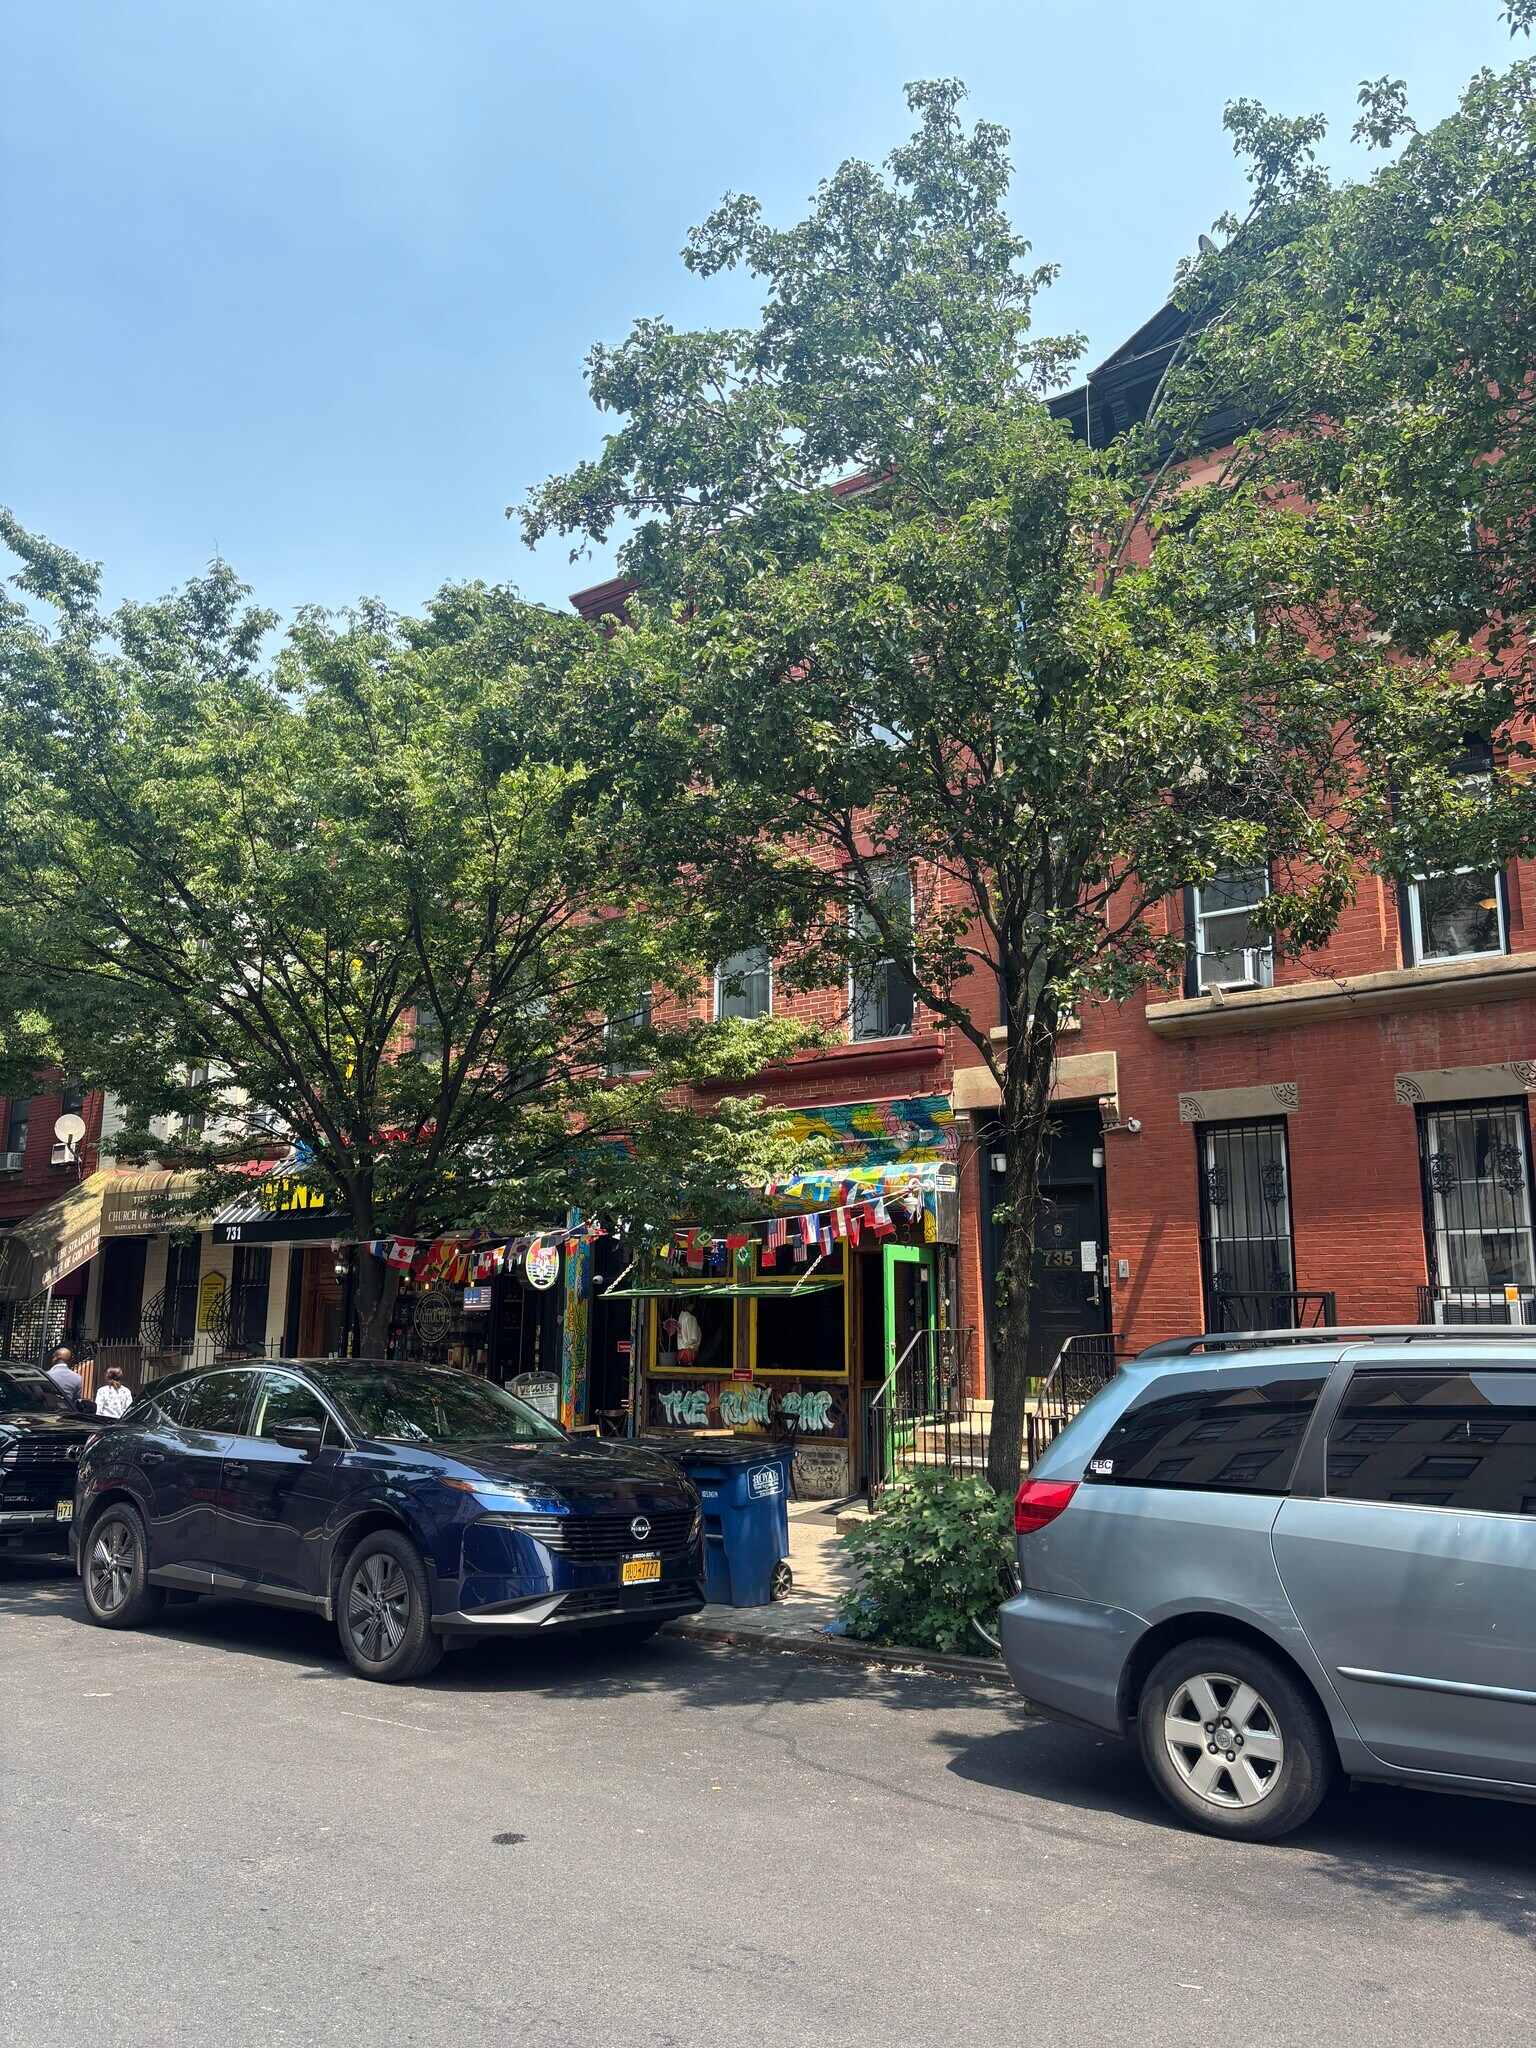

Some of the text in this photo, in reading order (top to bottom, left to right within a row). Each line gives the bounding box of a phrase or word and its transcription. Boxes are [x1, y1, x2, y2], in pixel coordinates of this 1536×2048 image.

[108, 1210, 137, 1222] CHURCH
[225, 1226, 242, 1240] 731
[1043, 1250, 1074, 1267] 735
[658, 1387, 835, 1431] THE RUM BAR
[1091, 1460, 1112, 1470] EBC
[58, 1506, 71, 1517] H71
